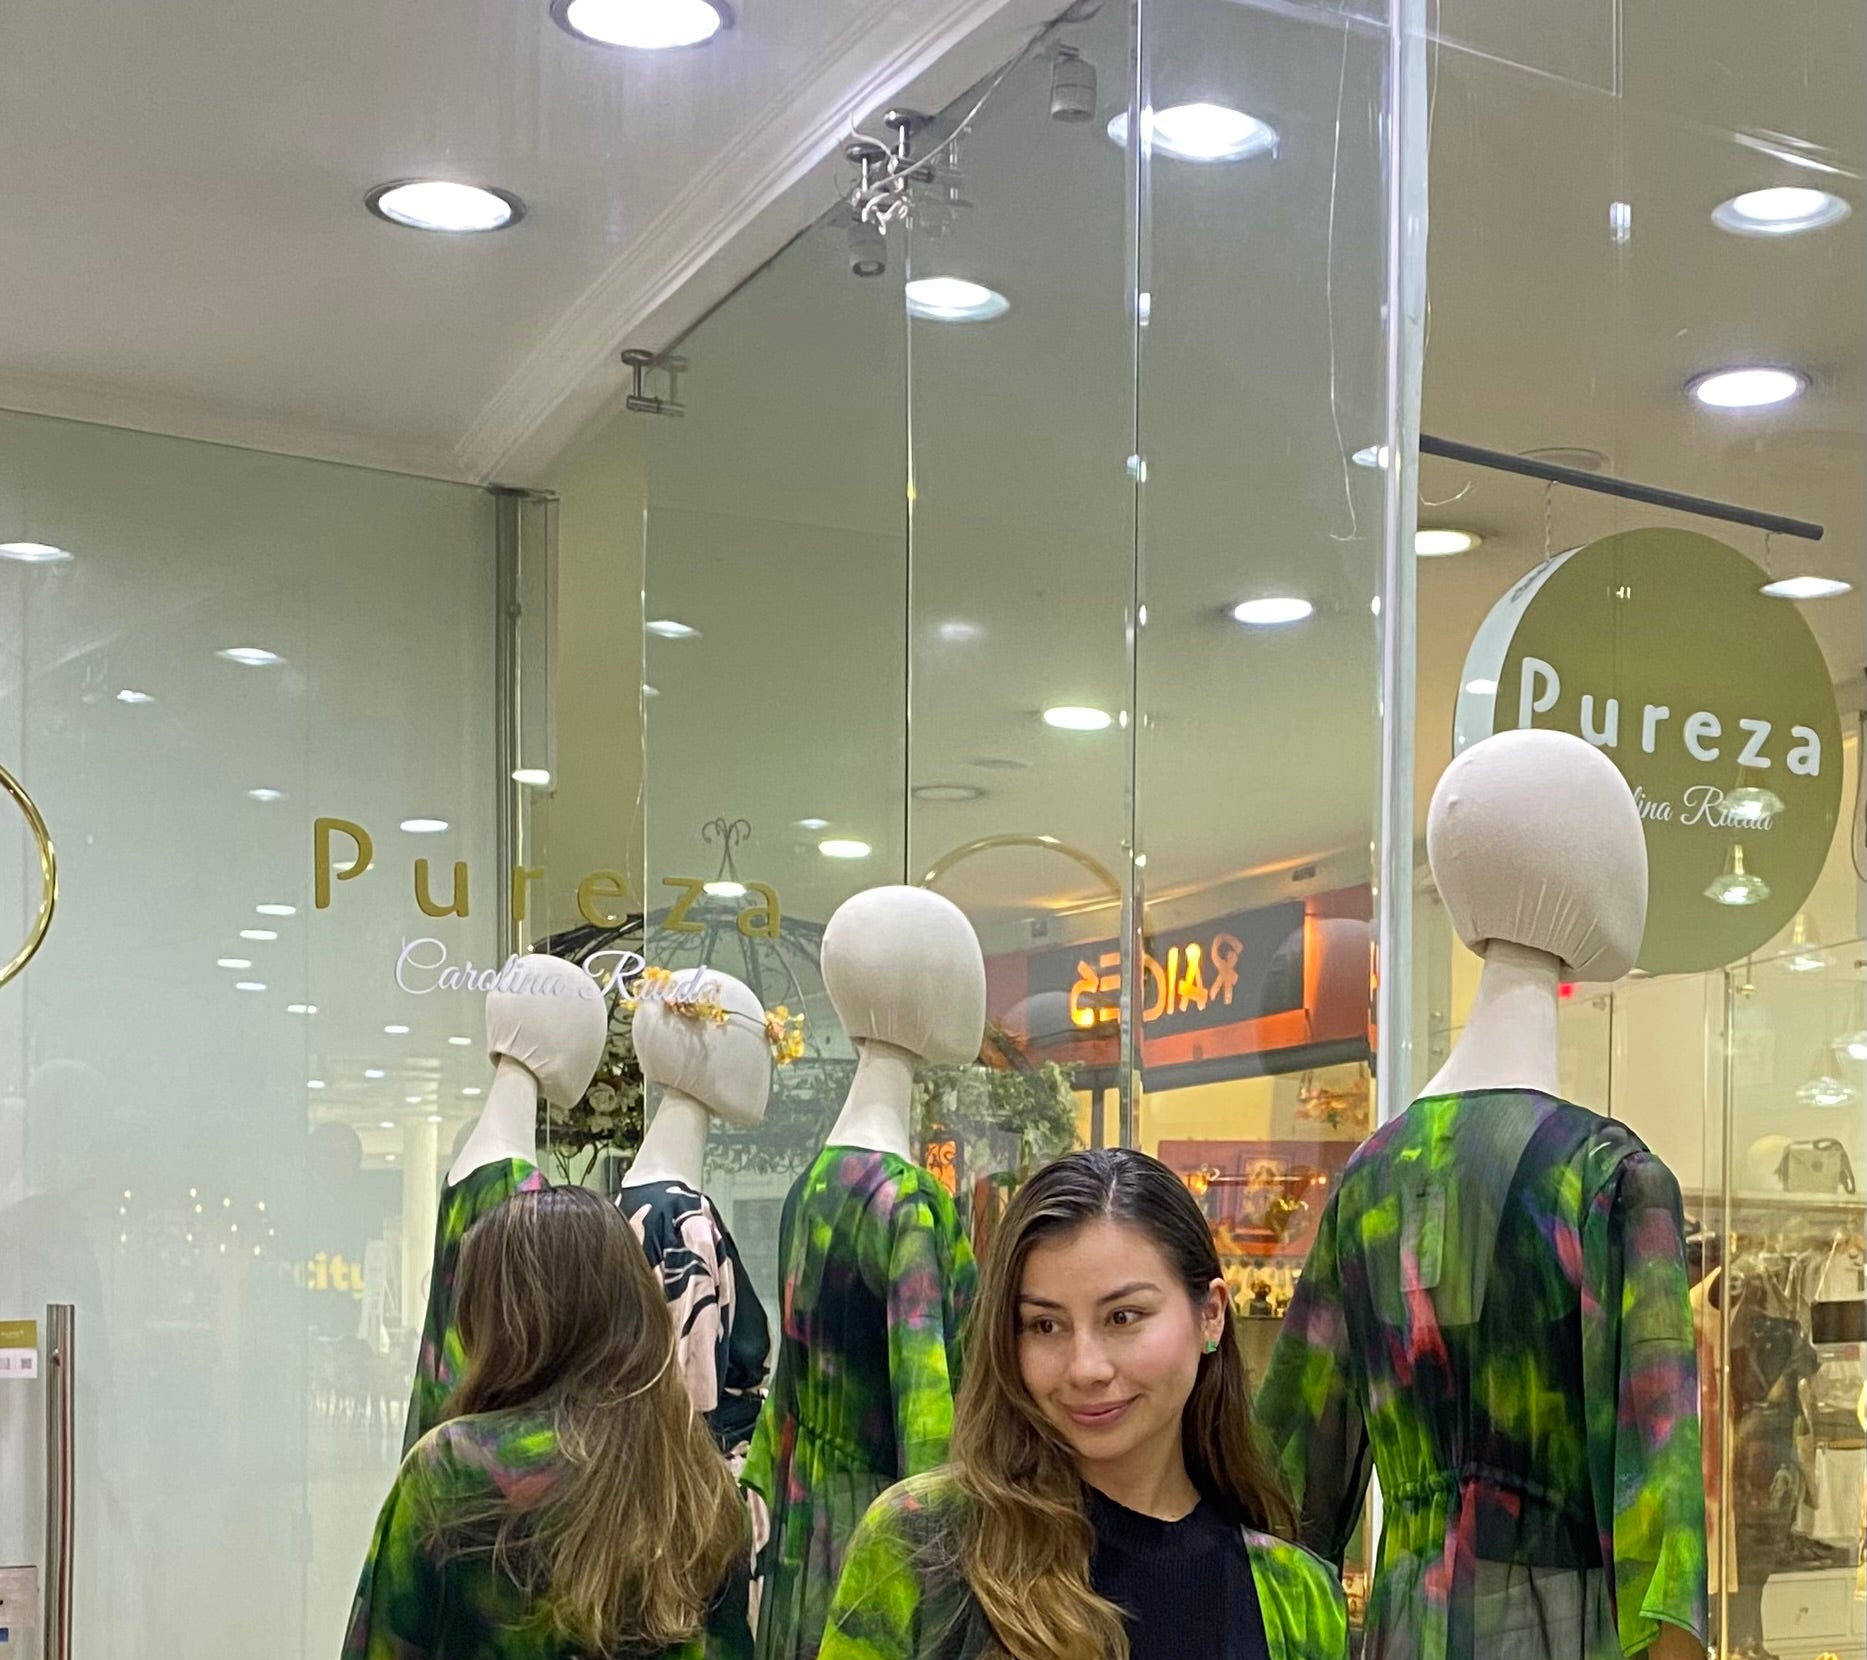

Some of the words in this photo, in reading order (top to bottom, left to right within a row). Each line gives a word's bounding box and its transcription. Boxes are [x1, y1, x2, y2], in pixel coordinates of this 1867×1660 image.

[1517, 656, 1822, 777] Pureza
[1632, 786, 1673, 822] lina
[314, 817, 781, 939] Pureza
[396, 936, 566, 997] Carolina
